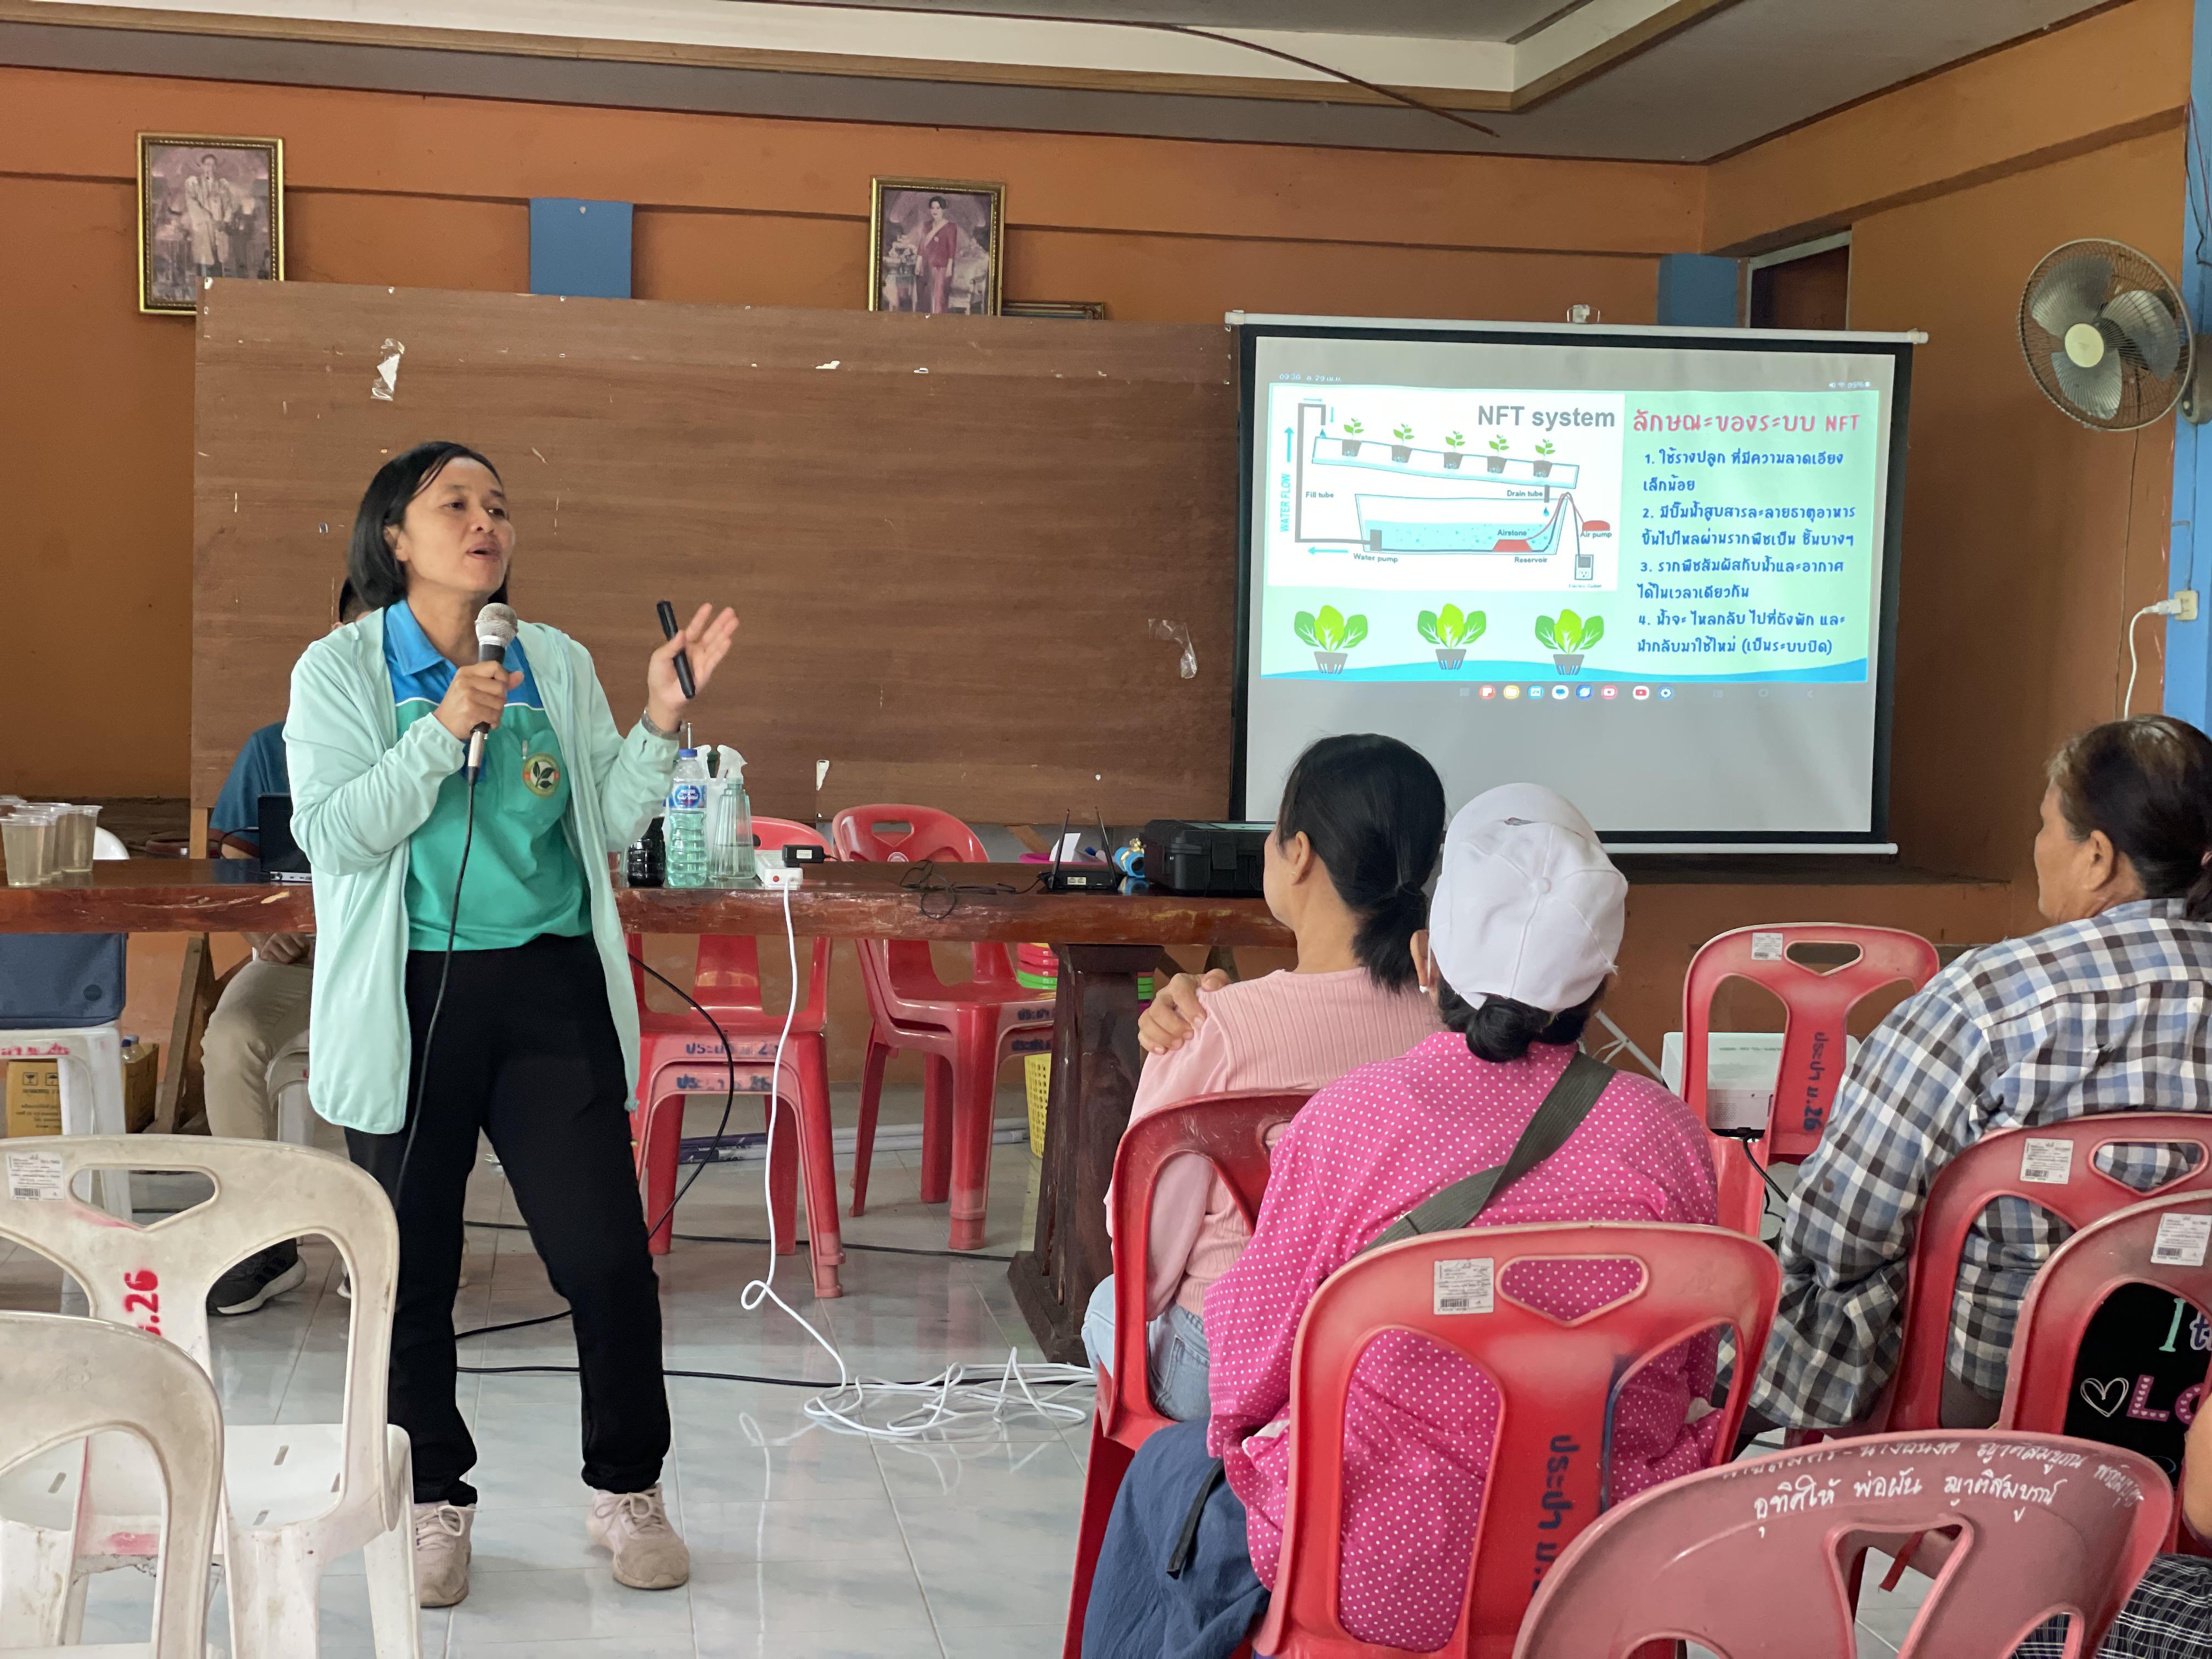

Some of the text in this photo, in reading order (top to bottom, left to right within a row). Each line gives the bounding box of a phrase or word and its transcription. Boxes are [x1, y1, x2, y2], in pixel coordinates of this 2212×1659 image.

[1478, 405, 1615, 432] NFT system
[1633, 409, 1860, 432] ลักษณะของระบบ NFT
[1644, 447, 1843, 467] 1. ใช้รางปลูก ที่มีความลาดเอียง
[1643, 474, 1695, 491] เล็กน้อย
[1280, 473, 1290, 532] WATER FLOW
[1642, 508, 1654, 518] 2.
[1353, 553, 1375, 561] Water
[1640, 555, 1843, 573] 3. รากพืชสัมผัสกับน้ำและอากาศ
[1637, 582, 1749, 599] ได้ในเวลาเดียวกัน
[1639, 615, 1651, 625] 4.
[1657, 608, 1686, 625] น้ำจะ
[1690, 610, 1746, 625] ไหลกลับ
[1820, 614, 1846, 626] และ
[1638, 635, 1832, 655] นำกลับมาใช้ใหม่ (เป็นระบบปิด)
[1537, 1434, 1579, 1529] ประปา
[1754, 1474, 1842, 1538] อุทิศให้
[1944, 1469, 2068, 1523] ญาติสมบูรณ์
